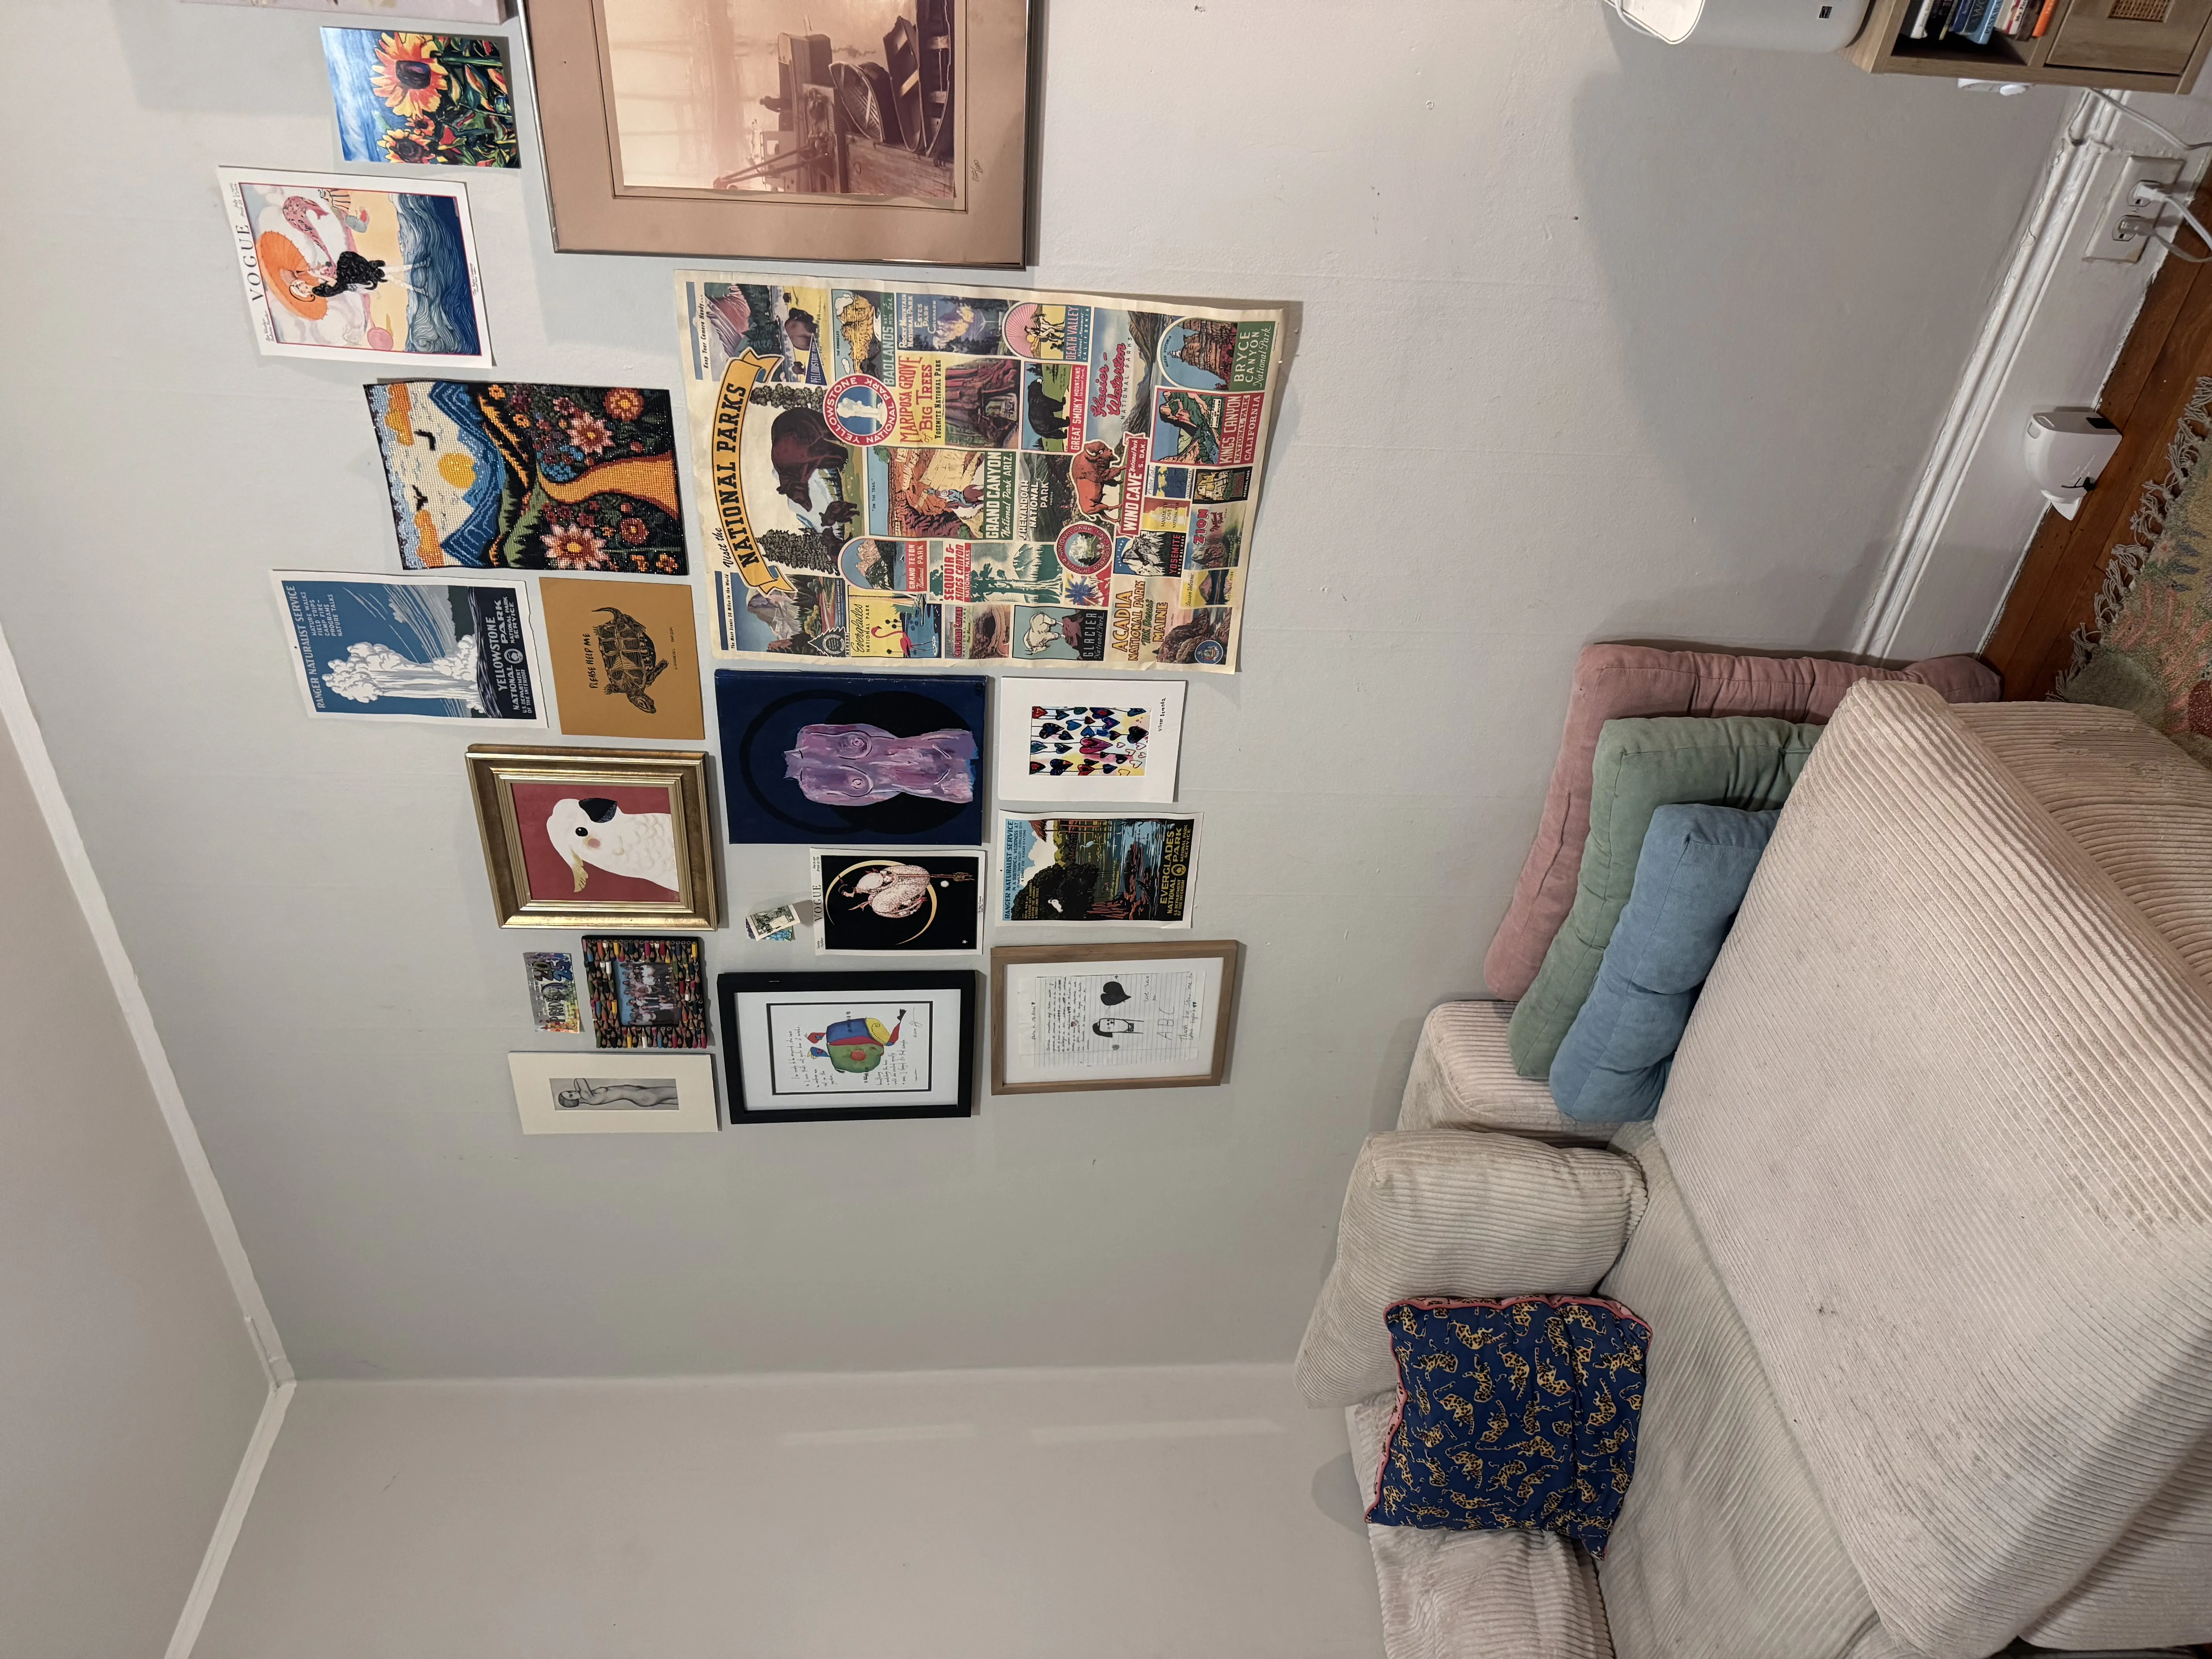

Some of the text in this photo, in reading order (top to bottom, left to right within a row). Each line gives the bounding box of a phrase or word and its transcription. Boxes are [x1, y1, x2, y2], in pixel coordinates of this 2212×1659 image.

[235, 225, 264, 302] VOGUE
[899, 294, 907, 348] ROCKY MOUNTAIN
[914, 304, 923, 328] ESTES
[927, 301, 936, 334] COLORADO
[1066, 306, 1079, 360] DEATH VALLEY
[882, 326, 895, 385] BADLANDS
[1234, 331, 1250, 382] BRYCE
[1245, 331, 1260, 383] CANYON
[1252, 325, 1271, 388] National Park
[898, 355, 923, 442] MARIPOSA GROVE
[1106, 343, 1126, 416] Waterton
[1120, 376, 1129, 420] NATIONAL
[716, 383, 746, 453] PARKS
[826, 377, 860, 443] YELLOWSTONE
[864, 378, 896, 443] NATIONAL PARK
[915, 364, 933, 443] of BIG TREES
[1072, 398, 1083, 424] SMOKY
[1071, 426, 1081, 450] GREAT
[1219, 395, 1242, 464] KINGS CANYON
[1234, 397, 1249, 461] NATIONAL PARK
[1244, 395, 1261, 461] CALIFORNIA
[1128, 452, 1138, 472] National
[716, 462, 759, 568] NATIONAL
[986, 452, 1002, 539] GRAND CANYON
[1000, 453, 1013, 538] National Park ARIZ.
[1018, 480, 1029, 540] SHENANDOAH
[1030, 481, 1040, 528] NATIONAL
[1040, 481, 1049, 508] PARK
[1123, 472, 1142, 531] WIND CAVE
[712, 527, 733, 567] Visit the
[1059, 530, 1072, 556] NATIONAL
[1117, 540, 1125, 551] DOME
[1193, 508, 1209, 544] ZION
[955, 544, 964, 601] KINGS CANYON
[1169, 534, 1181, 573] YOSEMITE
[916, 568, 925, 589] National
[944, 556, 954, 601] SEQUOIA
[301, 592, 317, 635] NATURE WALKS
[309, 599, 318, 616] TRIPS
[324, 604, 337, 636] PROGRAMS
[327, 594, 343, 637] NATURE TALKS
[494, 600, 508, 644] PARK
[507, 615, 515, 643] NATIONAL
[509, 602, 520, 639] SERVICE
[850, 603, 867, 652] Everglades
[1111, 590, 1133, 652] ACADIA
[1128, 579, 1146, 661] NATIONAL PARK
[1152, 601, 1168, 642] MAINE
[286, 586, 326, 708] RANGER NATURALIST SERVICE
[485, 617, 508, 691] YELLOWSTONE
[1083, 613, 1097, 656] GLACIER
[1094, 631, 1103, 659] National
[520, 669, 529, 695] INTERIOR
[582, 633, 598, 689] PLEASE HELP ME
[506, 665, 520, 710] NATIONAL
[1159, 831, 1175, 904] EVERGLADES
[1173, 827, 1182, 862] PARK
[812, 884, 823, 921] VOGUE
[1167, 878, 1176, 914] NATIONAL
